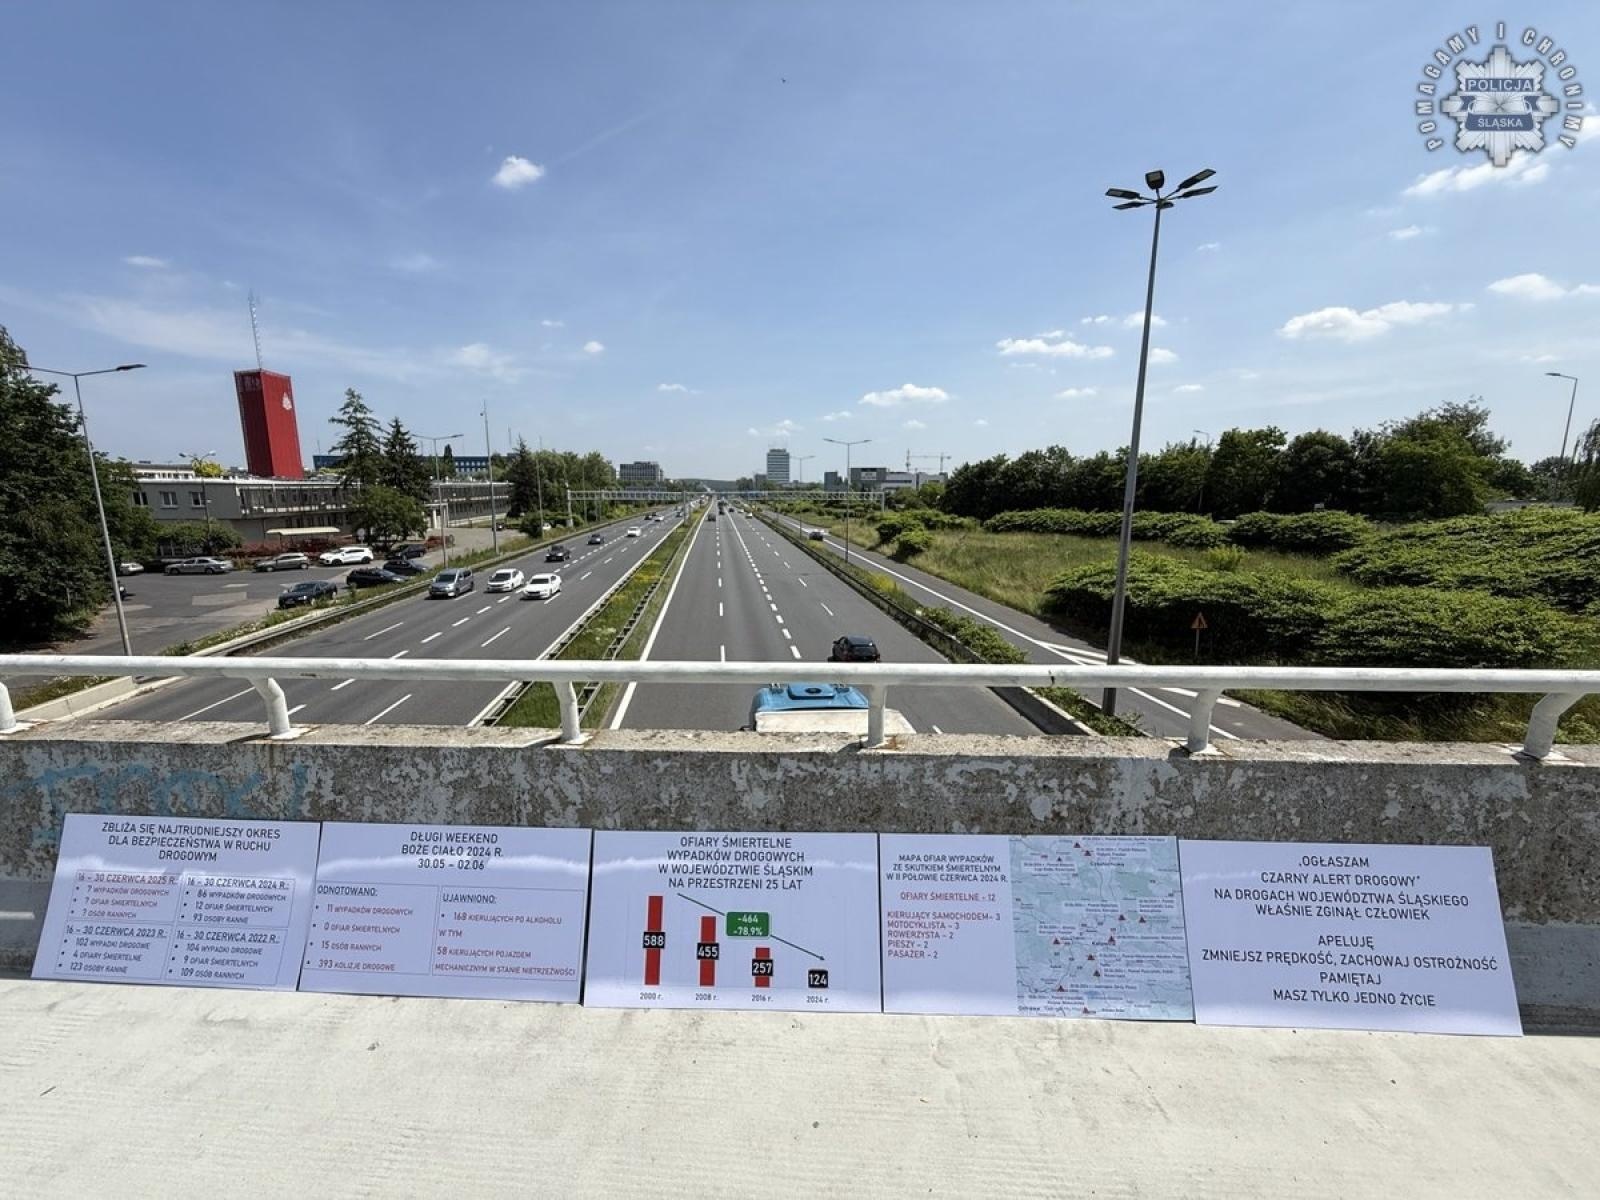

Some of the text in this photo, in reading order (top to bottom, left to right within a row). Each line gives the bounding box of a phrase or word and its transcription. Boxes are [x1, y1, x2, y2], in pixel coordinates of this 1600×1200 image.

[101, 822, 280, 839] ZBLIŻA SIĘ NAJTRUDNIEJSZY OKRES
[410, 831, 497, 843] DŁUGI WEEKEND
[680, 836, 791, 849] OFIARY ŚMIERTELNE
[108, 835, 270, 851] DLA BEZPIECZEŃSTWA W RUCHU
[158, 850, 216, 861] DROGOWYM
[401, 844, 503, 856] BOŻE CIAŁO 2024 R.
[667, 850, 804, 861] WYPADKÓW DROGOWYCH
[923, 854, 946, 862] OFIAR
[948, 854, 994, 862] WYPADKÓW
[418, 859, 484, 870] 30.05 02.06
[893, 863, 1000, 872] ZE SKUTKIEM ŚMIERTELNYM
[658, 864, 812, 877] W WOJEWÓDZTWIE ŚLĄSKIM
[78, 873, 84, 881] 16
[105, 874, 146, 885] CZERWCA
[147, 876, 166, 884] 2025
[902, 873, 937, 881] POŁOWIE
[940, 873, 978, 881] CZERWCA
[1261, 872, 1308, 883] CZARNY
[1313, 873, 1350, 884] ALERT
[187, 877, 276, 890] 16 30 CZERWCA 2024
[668, 878, 802, 889] NA PRZESTRZENI 25 LAT
[900, 891, 995, 901] OFIARY ŚMIERTELNE 12
[1214, 888, 1468, 906] NA DROGACH WOJEWÓDZTWA ŚLĄSKIEGO
[887, 911, 930, 921] KIERUJĄCY
[1255, 904, 1429, 920] WŁAŚNIE ZGINĄŁ CZŁOWIEK
[738, 915, 758, 923] -464
[887, 920, 959, 929] MOTOCYKLISTA 3
[66, 925, 155, 937] 16 30 CZERWCA 2023
[177, 930, 267, 943] 16 30 CZERWCA 2022
[887, 930, 953, 939] ROWERZYSTA 2
[644, 935, 664, 946] 588
[887, 940, 915, 948] PIESZY
[1318, 935, 1374, 950] APELUJĘ
[698, 946, 718, 957] 455
[887, 949, 937, 959] PASAŻER 2
[1202, 949, 1263, 962] ZMNIEJSZ
[1266, 951, 1336, 966] PRĘDKOŚĆ,
[1340, 953, 1409, 967] ZACHOWAJ
[1413, 955, 1497, 970] OSTROŻNOŚĆ
[753, 962, 772, 973] 257
[809, 974, 827, 985] 124
[1319, 971, 1381, 986] PAMIĘTAJ
[640, 992, 656, 1000] 2000
[806, 995, 822, 1003] 2024
[1273, 989, 1435, 1006] MASZ TYLKO JEDNO ŻYCIE
